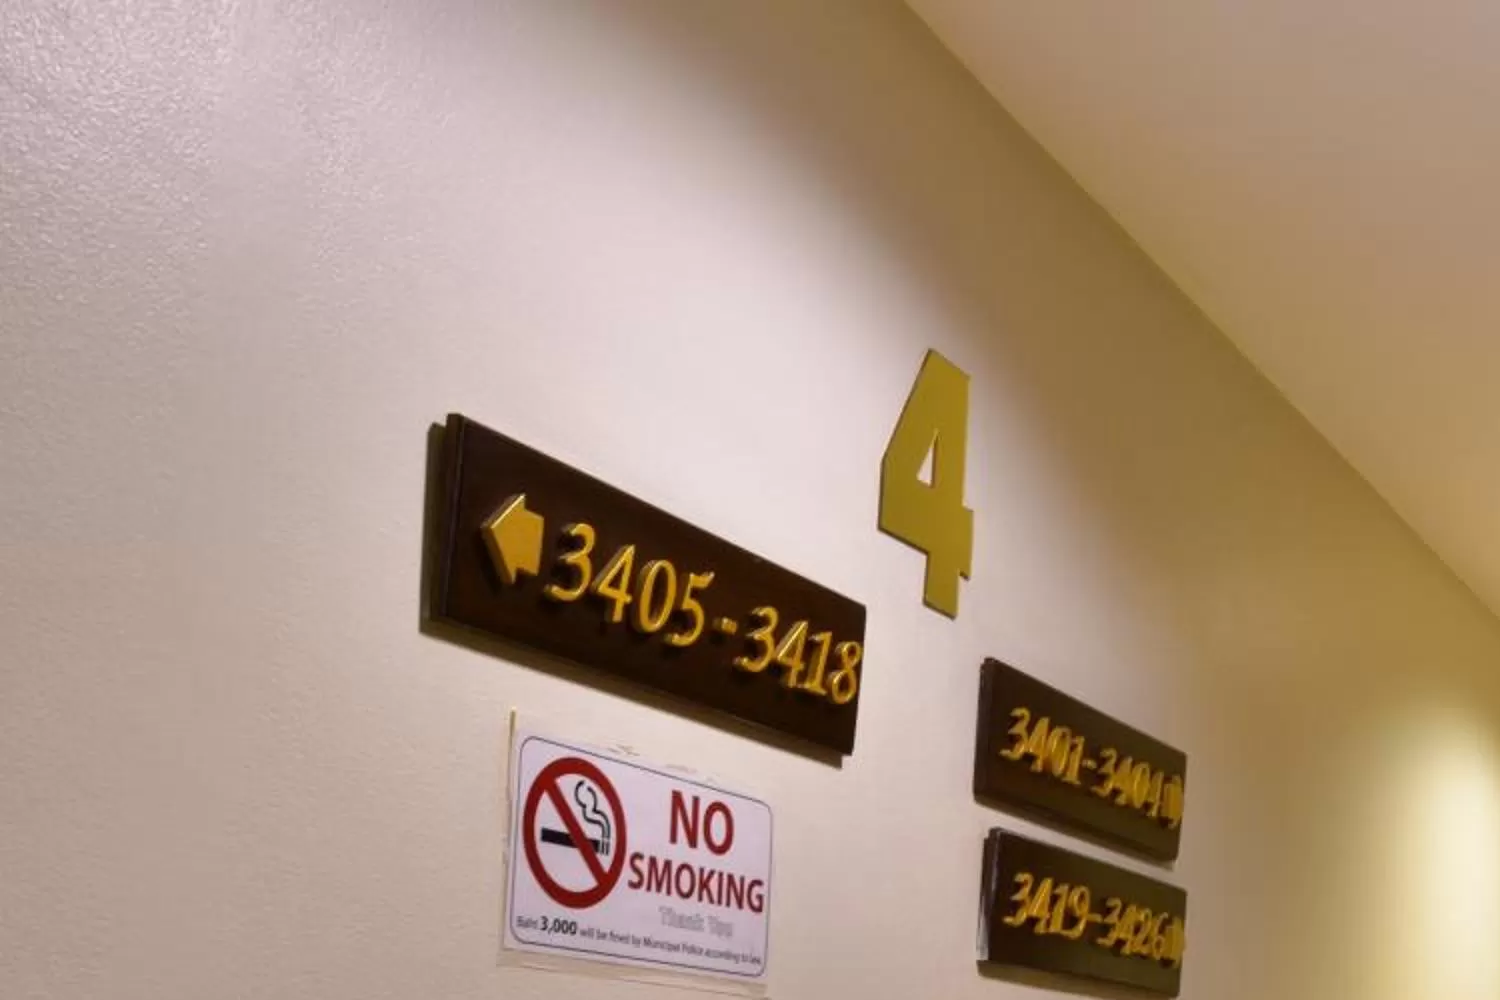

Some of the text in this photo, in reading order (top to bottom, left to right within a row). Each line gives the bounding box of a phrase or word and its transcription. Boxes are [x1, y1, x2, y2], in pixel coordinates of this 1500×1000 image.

[877, 348, 974, 620] 4
[544, 521, 864, 704] 3405-3418
[669, 789, 734, 855] NO
[627, 852, 765, 913] SMOKING
[540, 915, 578, 936] 3,000
